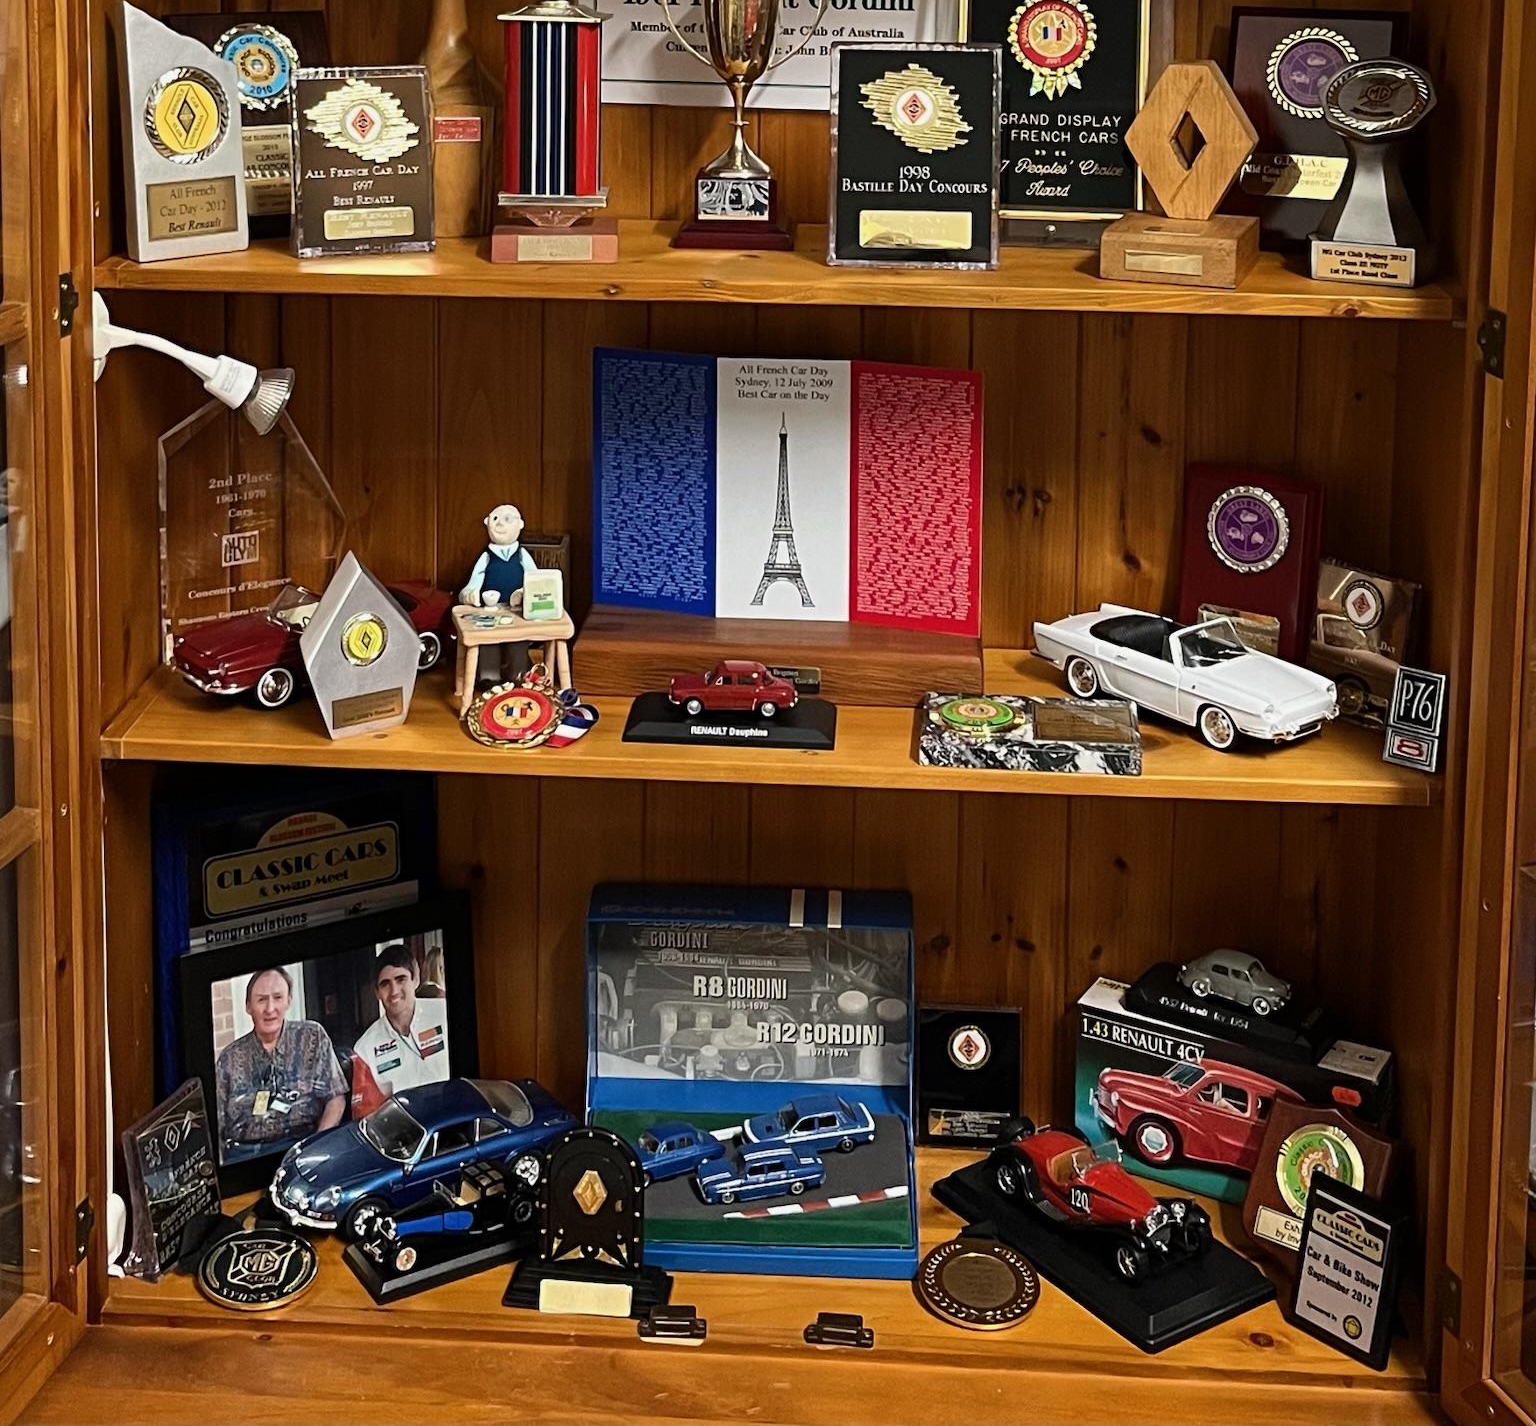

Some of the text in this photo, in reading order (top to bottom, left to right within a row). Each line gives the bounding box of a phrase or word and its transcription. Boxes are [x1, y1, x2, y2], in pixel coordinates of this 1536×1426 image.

[631, 21, 680, 33] Memb
[683, 23, 697, 33] of
[800, 26, 905, 39] Cub of Australia
[239, 37, 253, 45] Car
[786, 45, 815, 56] Jhn
[250, 85, 273, 95] 2010
[1368, 86, 1390, 101] MG
[1000, 113, 1122, 128] GRAND DISPLAY
[1011, 129, 1119, 144] FRENCH CARS
[255, 152, 289, 162] CLASSIC
[305, 164, 420, 179] ALL FRENCH CAR DAY
[899, 165, 931, 180] 1998
[1015, 158, 1074, 177] Peoples'
[1079, 159, 1124, 176] Choice
[170, 185, 217, 200] All French
[353, 180, 375, 191] 1997
[842, 177, 989, 194] BASTILLE DAY CONCOURS
[1025, 179, 1071, 197] Award
[159, 199, 227, 217] Car Day 2012
[333, 195, 395, 206] BEST RENAULT
[168, 217, 222, 233] Best Renault
[1347, 250, 1363, 258] Club
[1365, 252, 1388, 261] Sydney
[739, 365, 829, 378] All French Car Day
[735, 377, 834, 390] Sydney, 12 July 2009
[738, 389, 758, 399] Best
[760, 390, 777, 399] Car
[794, 390, 809, 400] the
[811, 391, 831, 403] Day
[208, 472, 273, 490] 2nd Place
[216, 489, 267, 505] 1961-1970
[188, 577, 292, 600] Concours d'Elegance
[178, 614, 217, 626] Shannons
[1380, 640, 1396, 654] DAY
[690, 725, 769, 738] RENAULT Dauphine
[216, 838, 388, 889] CLASSIC CARS
[257, 869, 350, 899] & Swap Meet
[205, 911, 309, 943] Congratulations
[650, 930, 709, 949] GORDINI
[693, 974, 788, 1000] R8 GORDINI
[756, 1021, 887, 1047] R12 GORDINI
[1082, 1017, 1205, 1064] 1.43 RENAULT 4CV
[1316, 1213, 1354, 1239] CLASSIC
[1275, 1227, 1285, 1241] by
[243, 1252, 276, 1272] MG
[1307, 1245, 1380, 1292] Car & Bike Show
[222, 1286, 280, 1302] SYDNEY
[1307, 1265, 1374, 1309] September 2012
